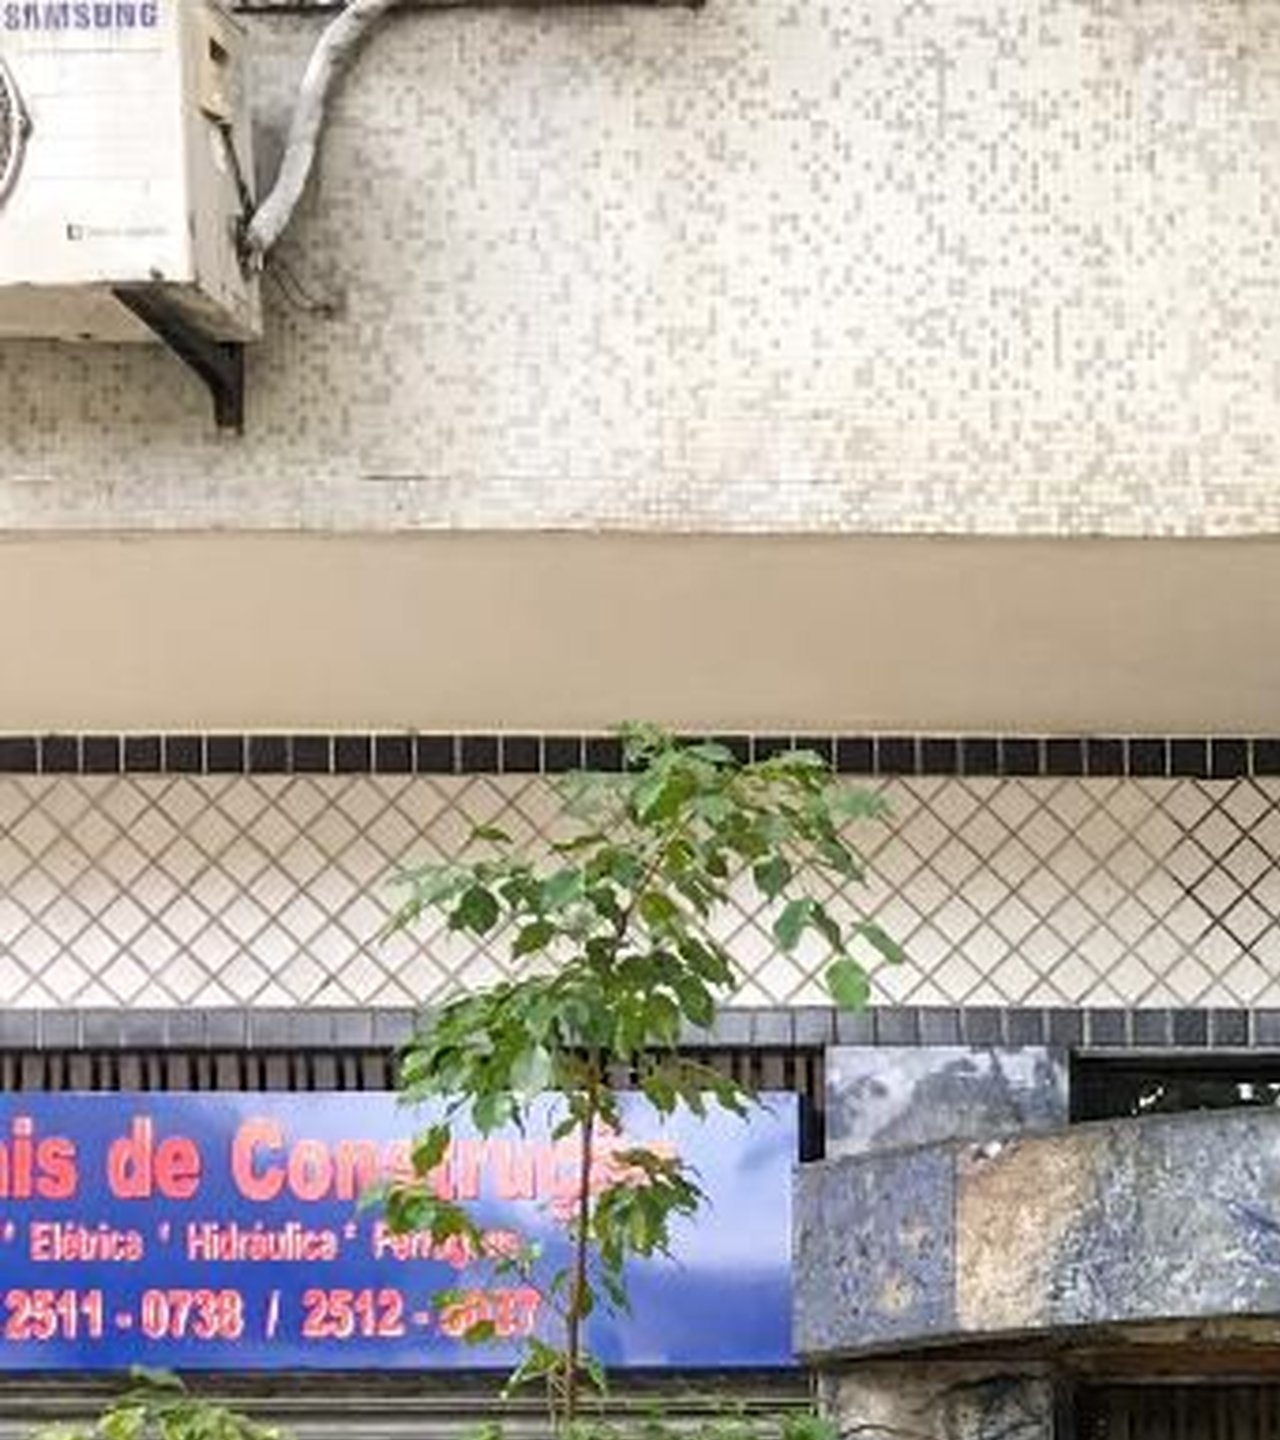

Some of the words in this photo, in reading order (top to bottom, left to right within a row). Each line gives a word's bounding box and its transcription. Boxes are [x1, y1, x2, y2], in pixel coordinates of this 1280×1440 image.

[4, 2, 158, 30] SAMSUNG
[0, 1116, 77, 1199] is
[107, 1116, 201, 1199] de
[30, 1220, 143, 1261] Elétrica
[187, 1220, 338, 1261] Hidráulica
[4, 1289, 103, 1340] 2511
[141, 1289, 243, 1338] 0738
[302, 1288, 405, 1338] 2512
